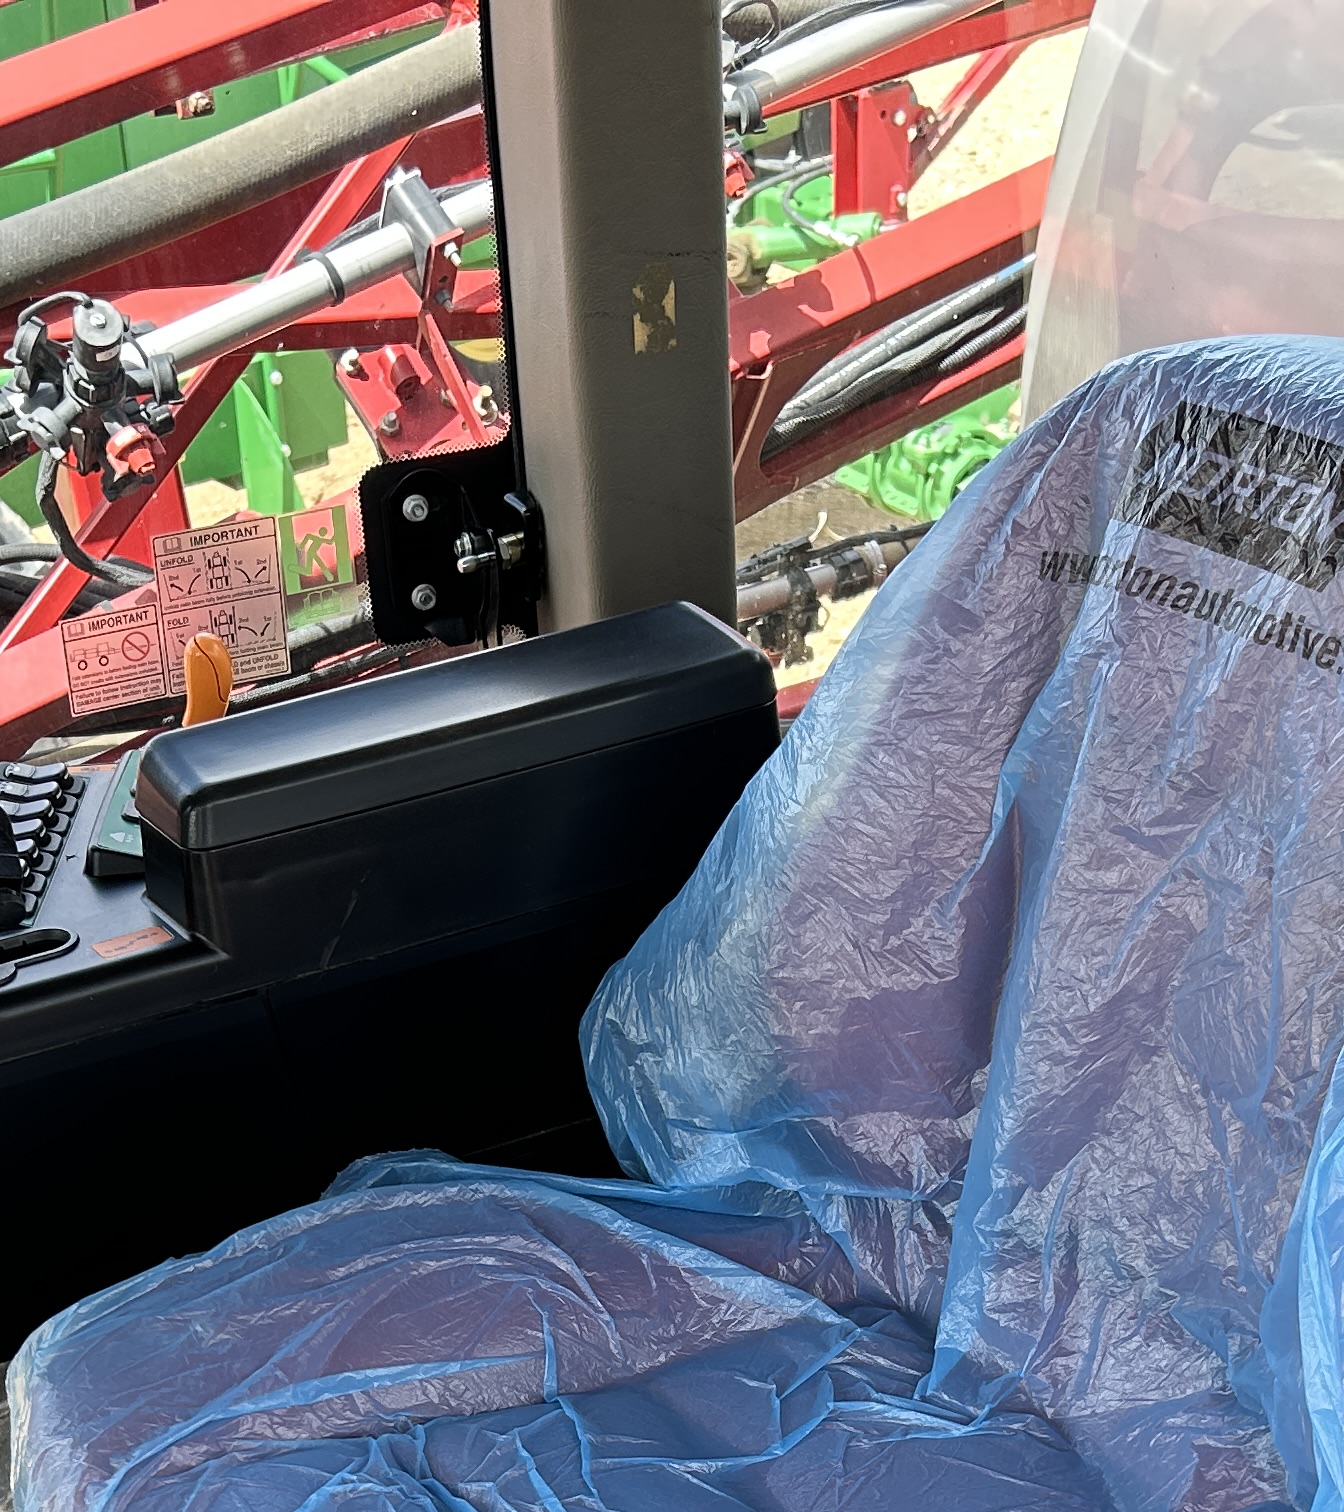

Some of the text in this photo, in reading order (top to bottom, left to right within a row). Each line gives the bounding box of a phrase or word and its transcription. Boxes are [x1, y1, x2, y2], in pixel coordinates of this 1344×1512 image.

[190, 525, 259, 546] IMPORTANT
[160, 555, 193, 567] UNFOLD
[88, 611, 149, 631] IMPORTANT
[167, 617, 188, 626] FOLD
[75, 692, 94, 700] Failure
[76, 697, 101, 707] DAMAGE
